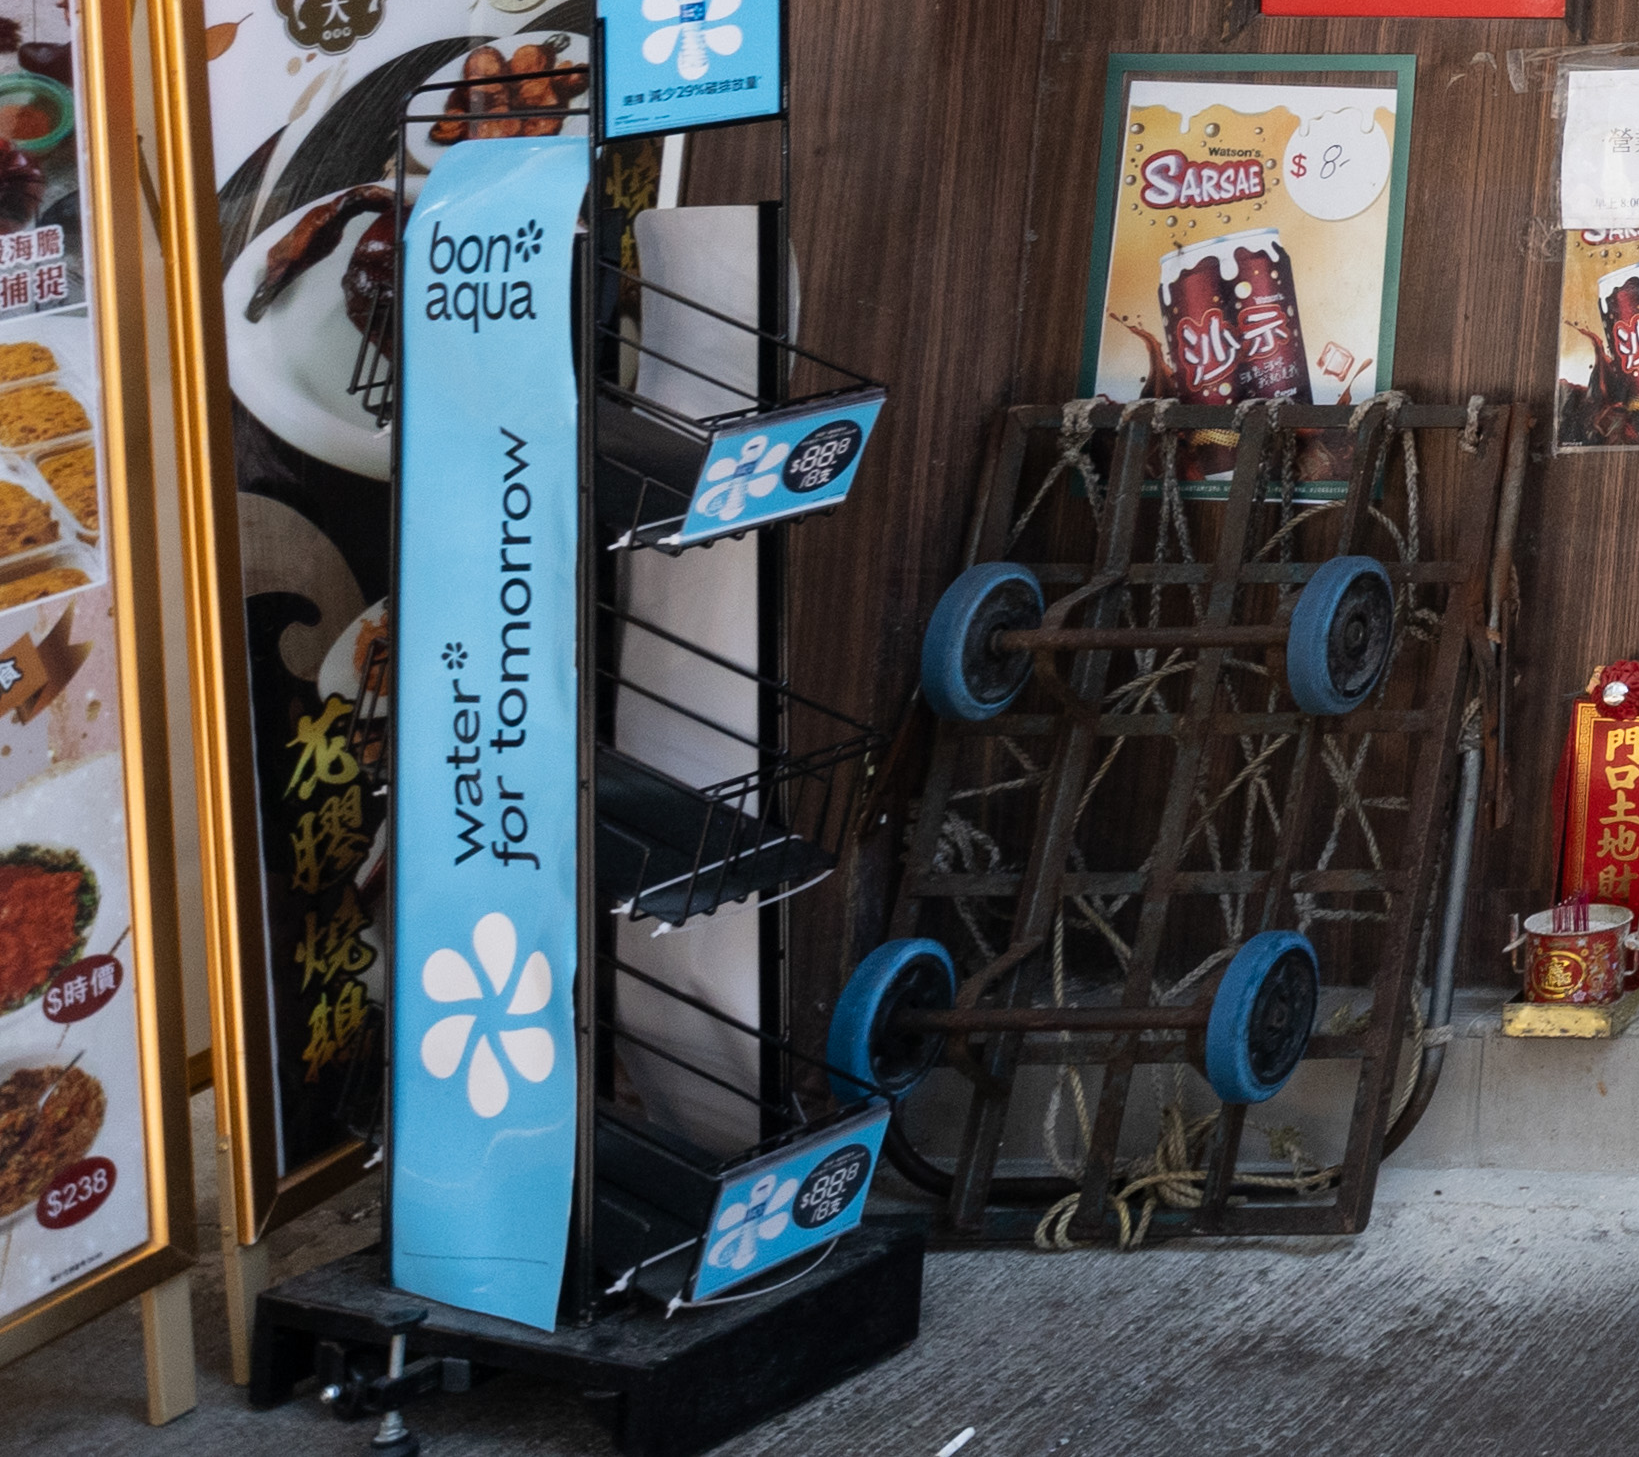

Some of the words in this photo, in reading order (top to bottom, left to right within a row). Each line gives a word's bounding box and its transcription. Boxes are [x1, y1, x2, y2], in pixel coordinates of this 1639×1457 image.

[1143, 154, 1262, 205] SARSAE
[1208, 146, 1261, 158] Watson's
[1290, 153, 1308, 178] $
[429, 219, 512, 276] bon
[425, 276, 537, 334] aqua
[1182, 310, 1289, 386] 沙示
[489, 426, 533, 754] tomorrow
[449, 678, 487, 866] water
[491, 789, 542, 870] for
[46, 963, 118, 1016] $時價
[46, 1166, 109, 1219] $238
